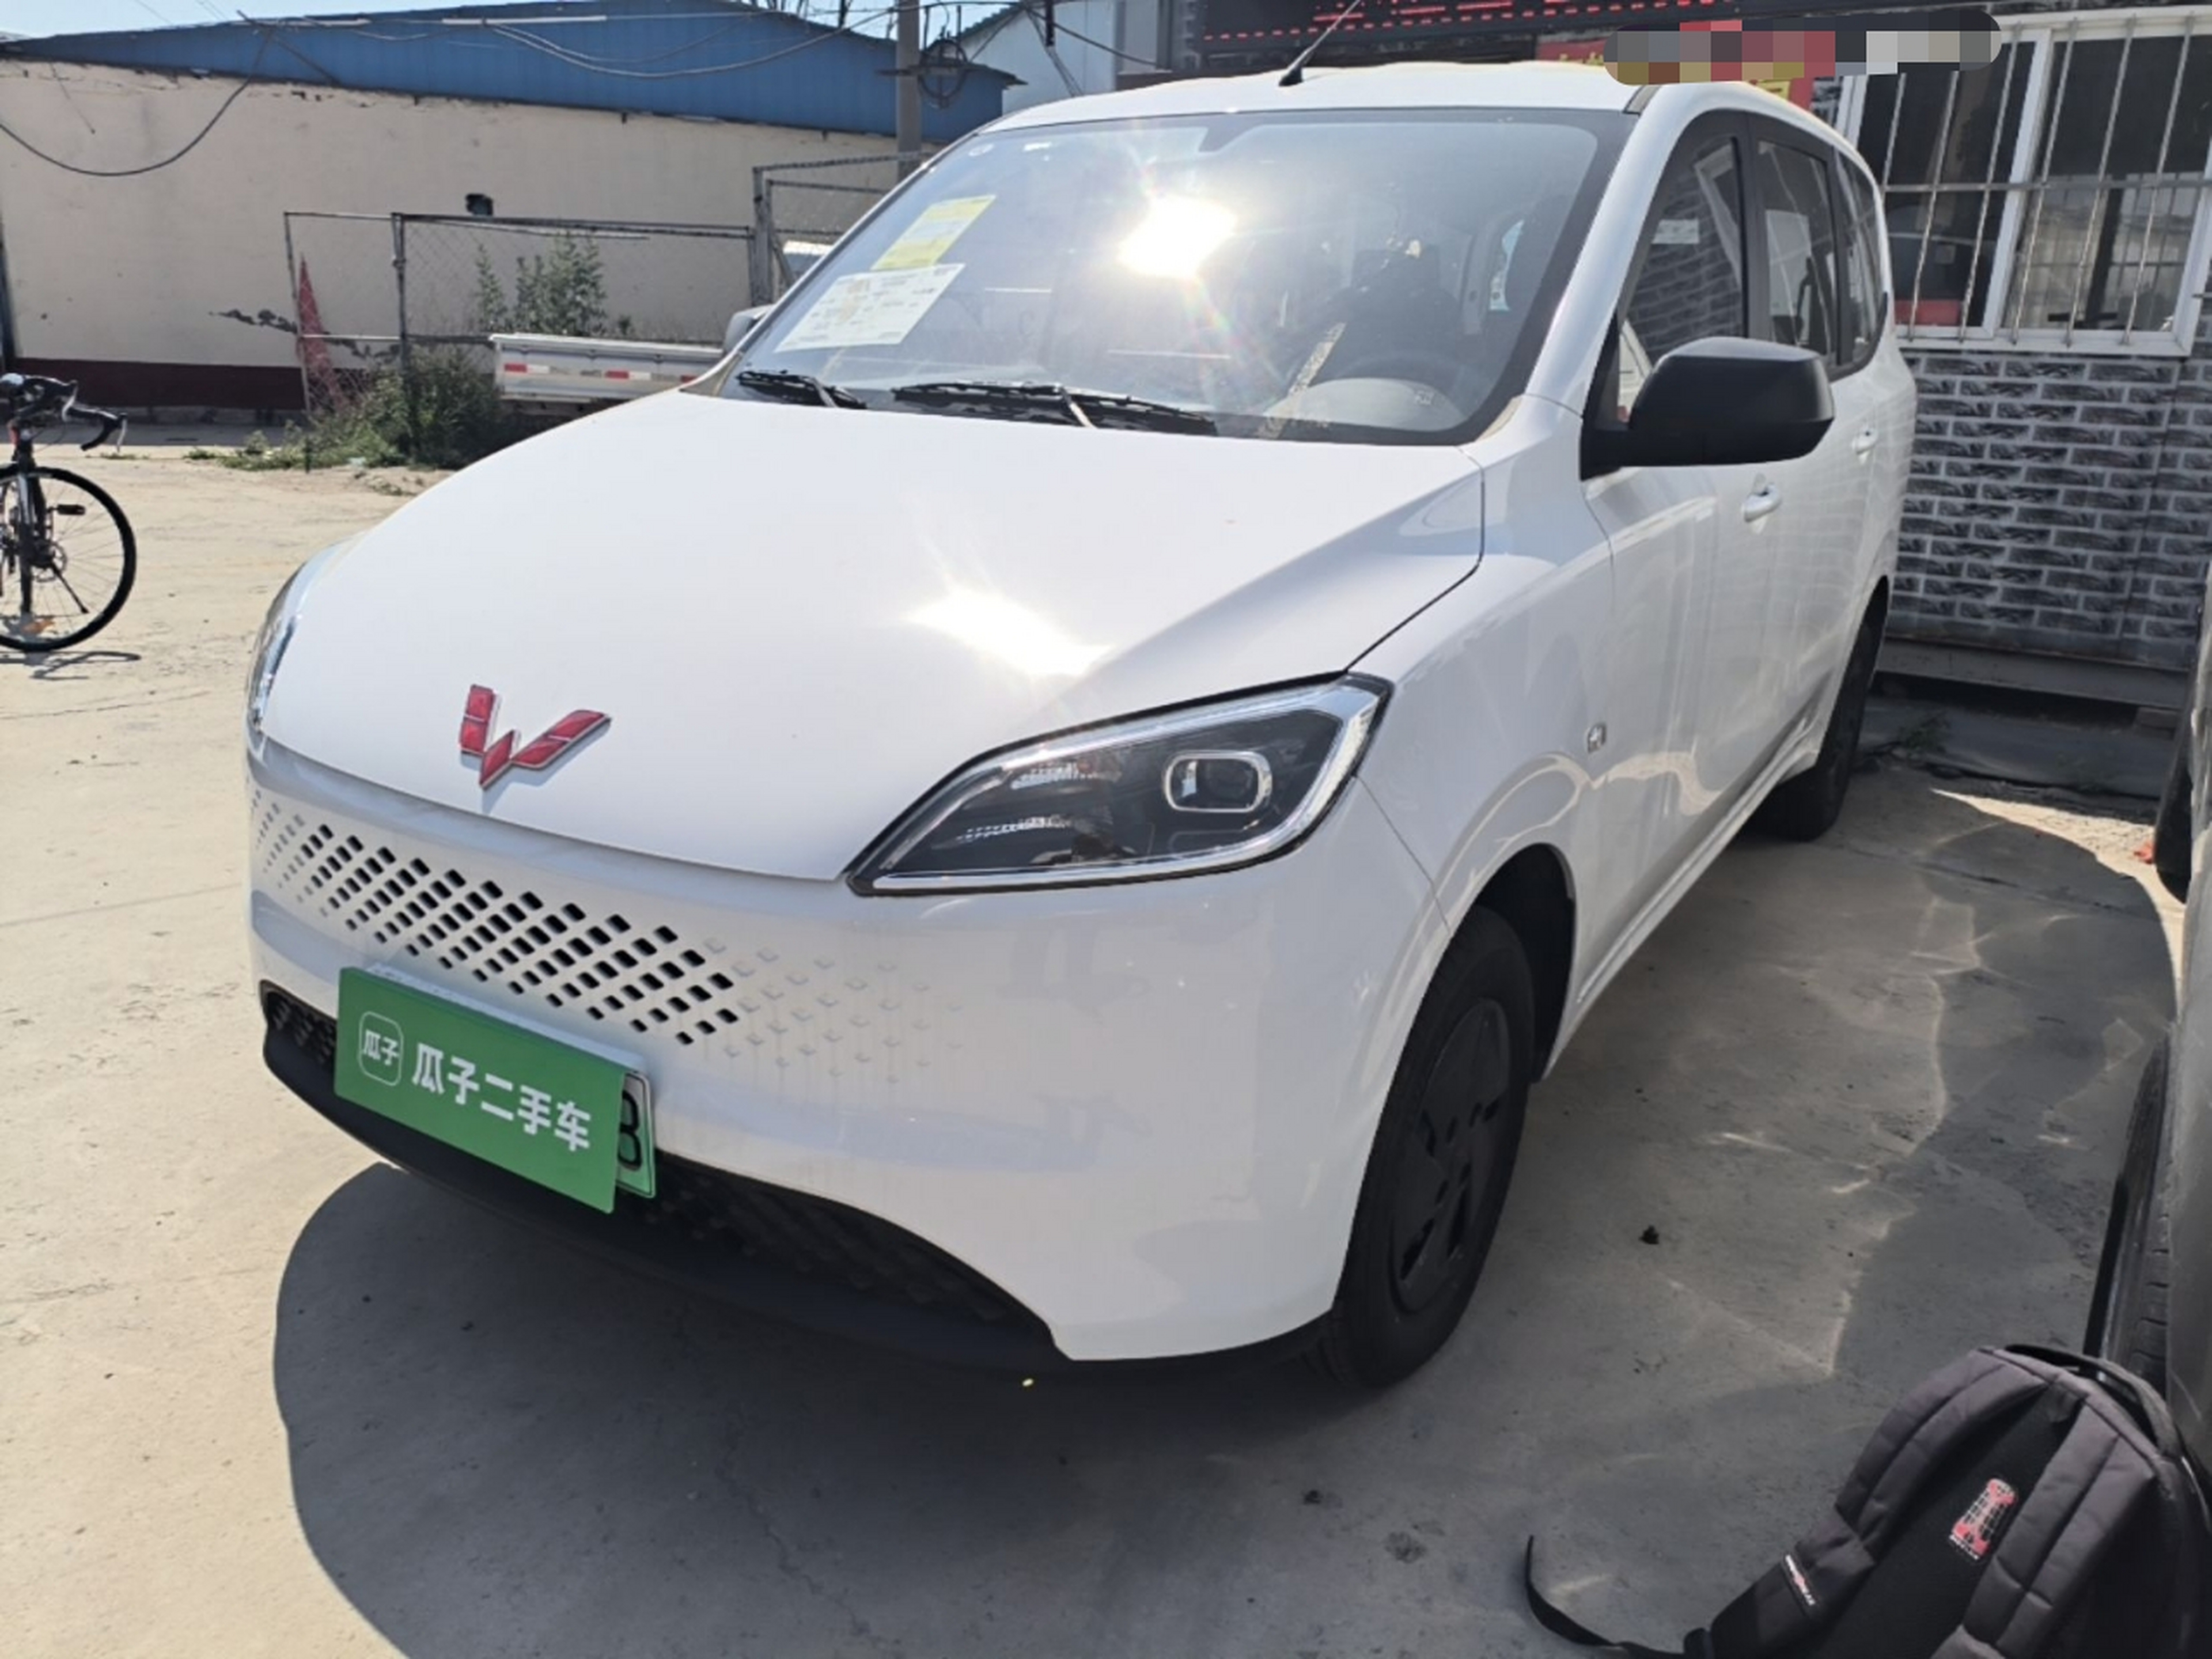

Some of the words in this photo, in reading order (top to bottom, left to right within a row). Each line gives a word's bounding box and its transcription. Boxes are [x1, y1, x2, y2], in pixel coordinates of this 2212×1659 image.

[363, 1029, 399, 1065] 瓜子
[411, 1043, 591, 1151] 瓜子二手车
